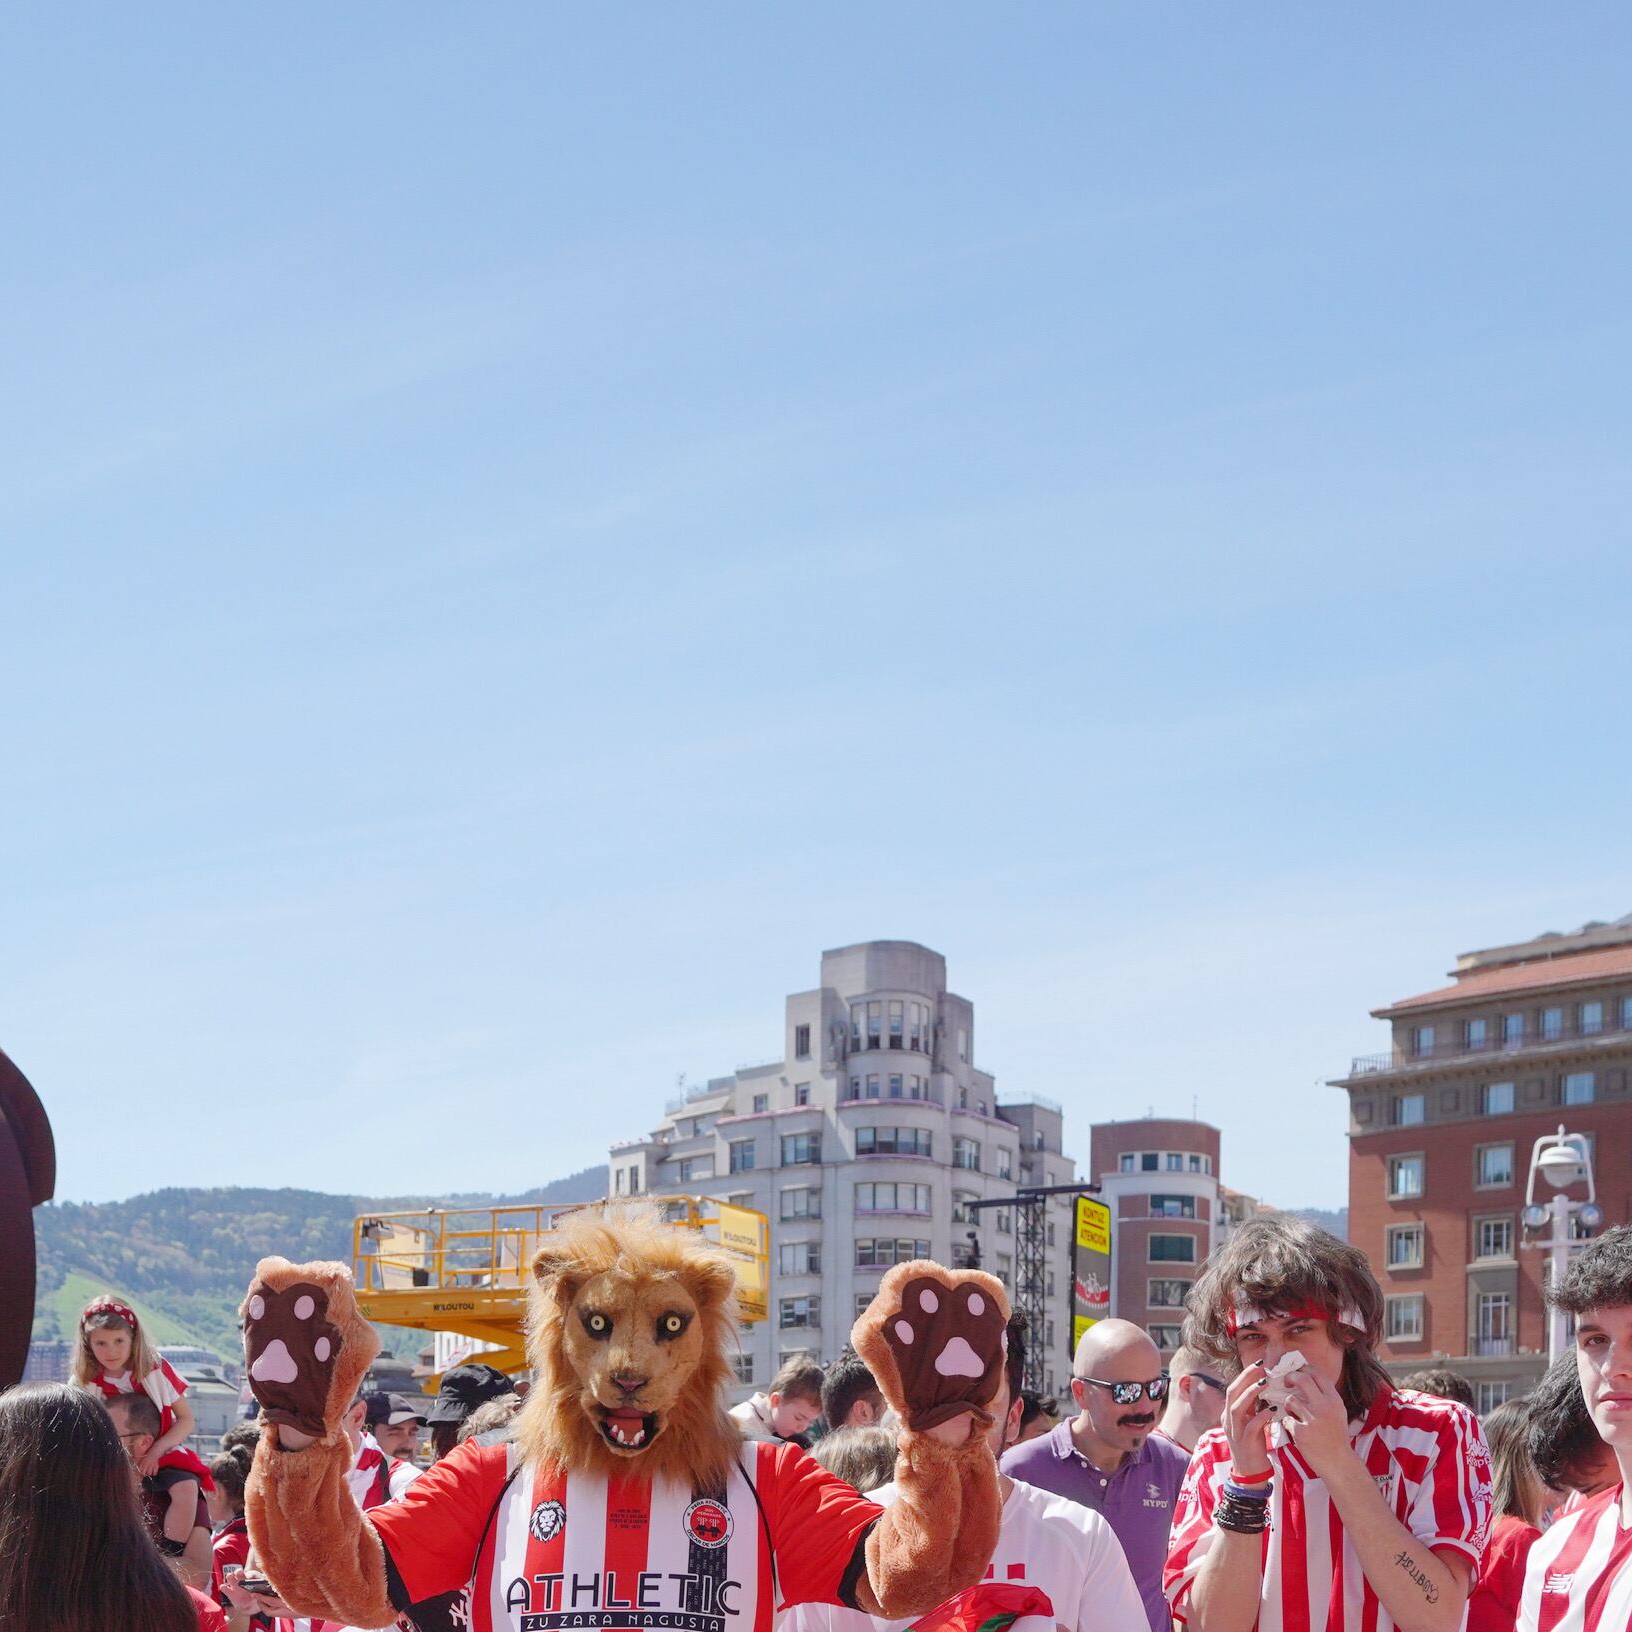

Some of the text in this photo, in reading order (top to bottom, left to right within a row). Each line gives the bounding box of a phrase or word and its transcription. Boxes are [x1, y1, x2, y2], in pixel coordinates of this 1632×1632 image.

[1083, 1205, 1105, 1224] KONTUZ
[1143, 1499, 1168, 1509] NYPD
[507, 1573, 742, 1616] ATHLETIC
[526, 1614, 719, 1632] ZU ZARA NAGUSIA
